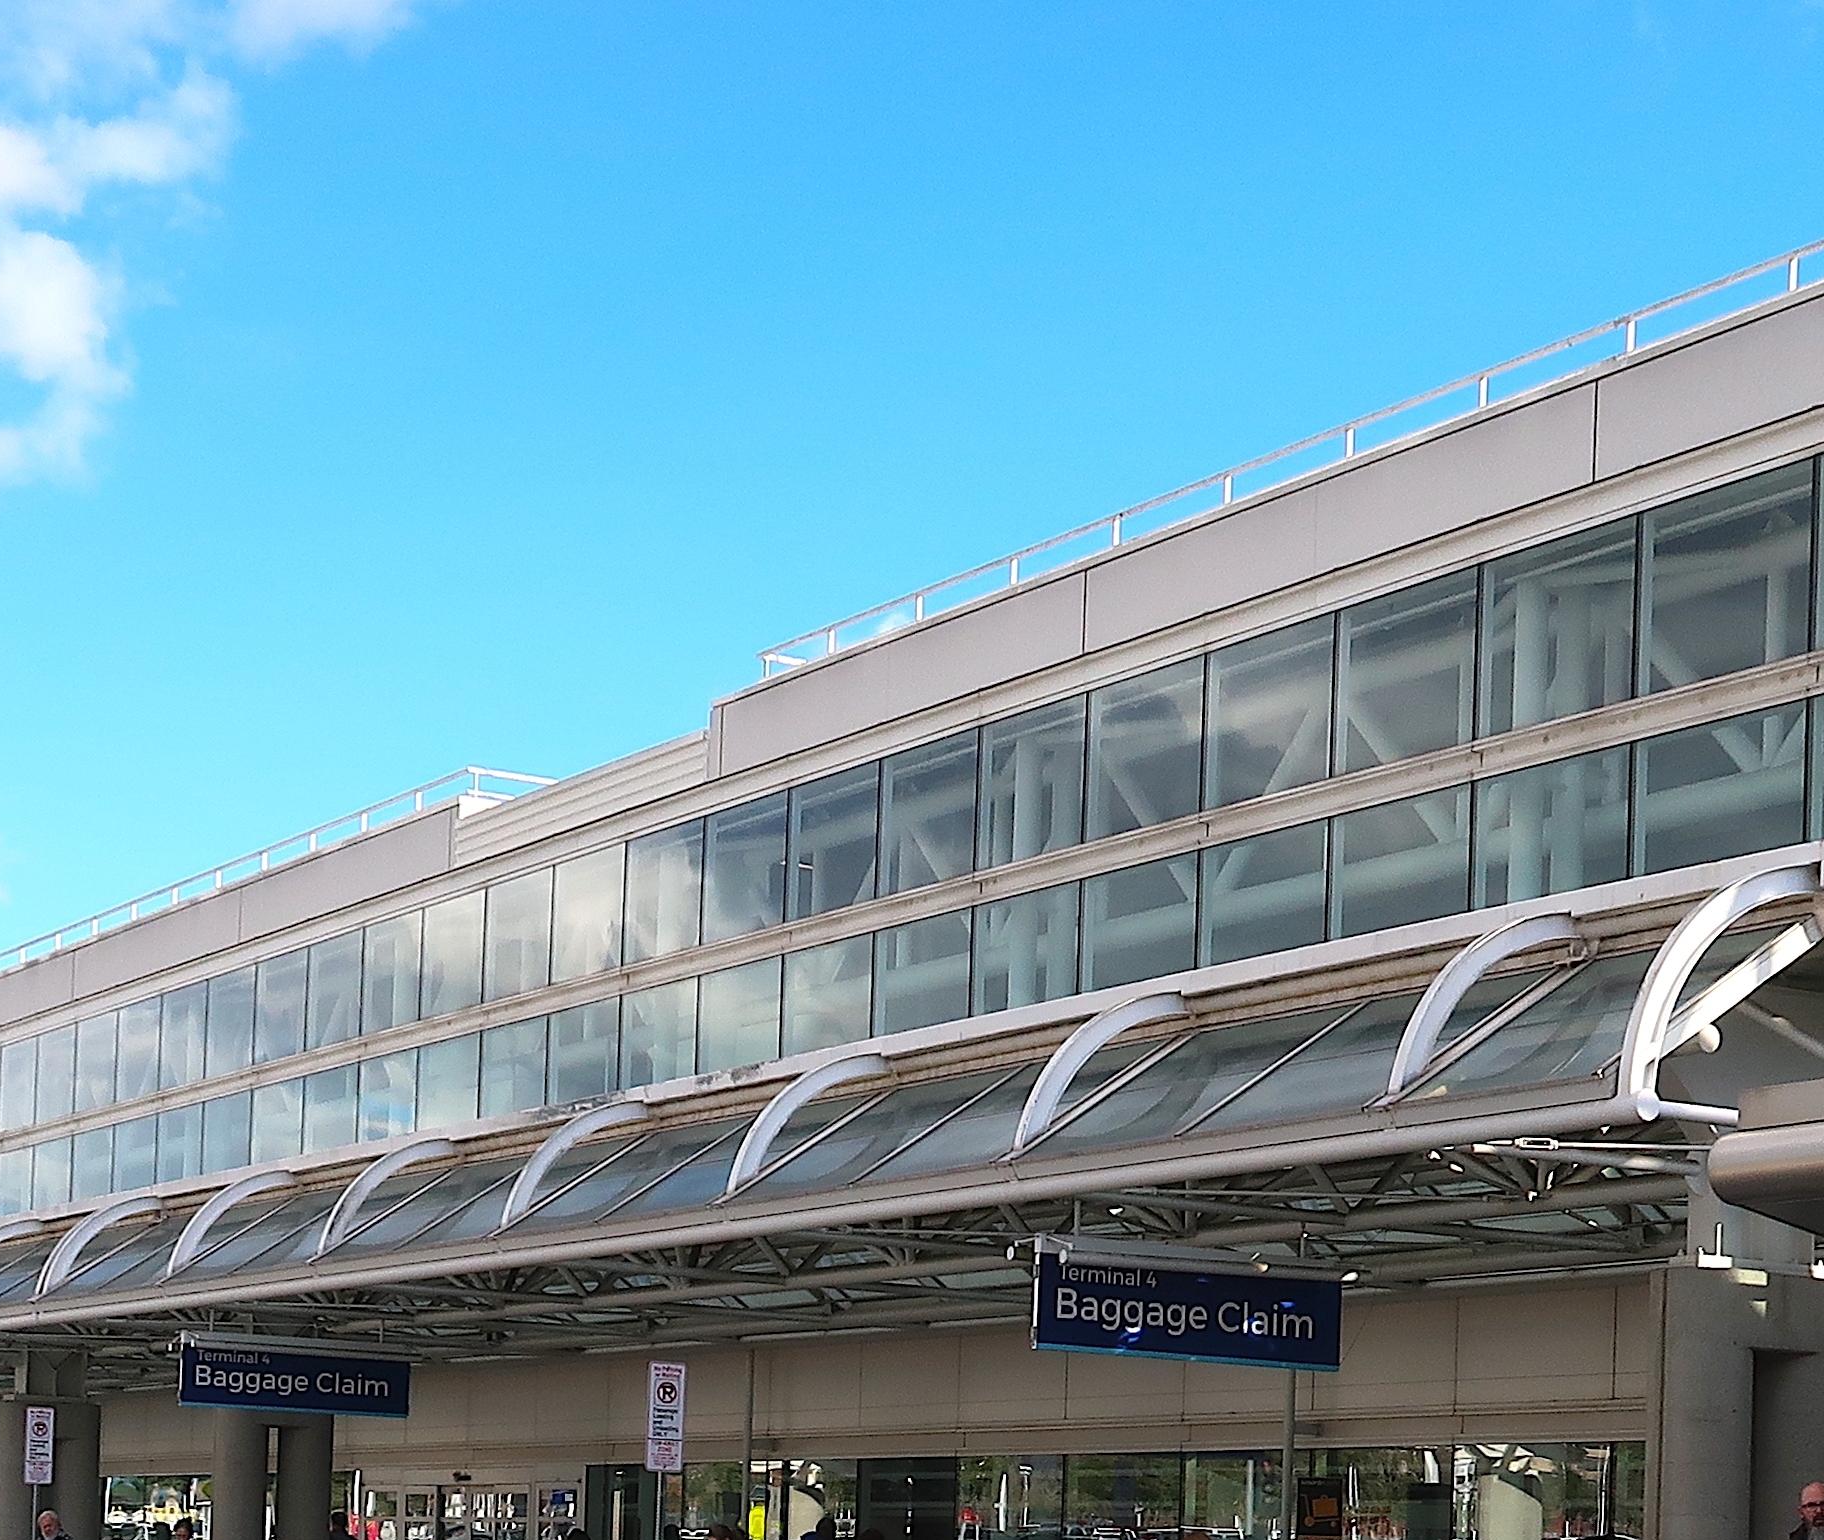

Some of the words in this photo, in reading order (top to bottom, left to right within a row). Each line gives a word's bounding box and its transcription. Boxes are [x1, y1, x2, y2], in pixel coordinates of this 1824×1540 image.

[1060, 1264, 1141, 1287] Terminal
[1145, 1271, 1157, 1288] 4
[1056, 1287, 1208, 1336] Baggage
[1218, 1301, 1314, 1340] Claim
[197, 1350, 259, 1364] Terminal
[261, 1354, 271, 1365] 4
[195, 1364, 309, 1396] Baggage
[316, 1372, 389, 1397] Claim
